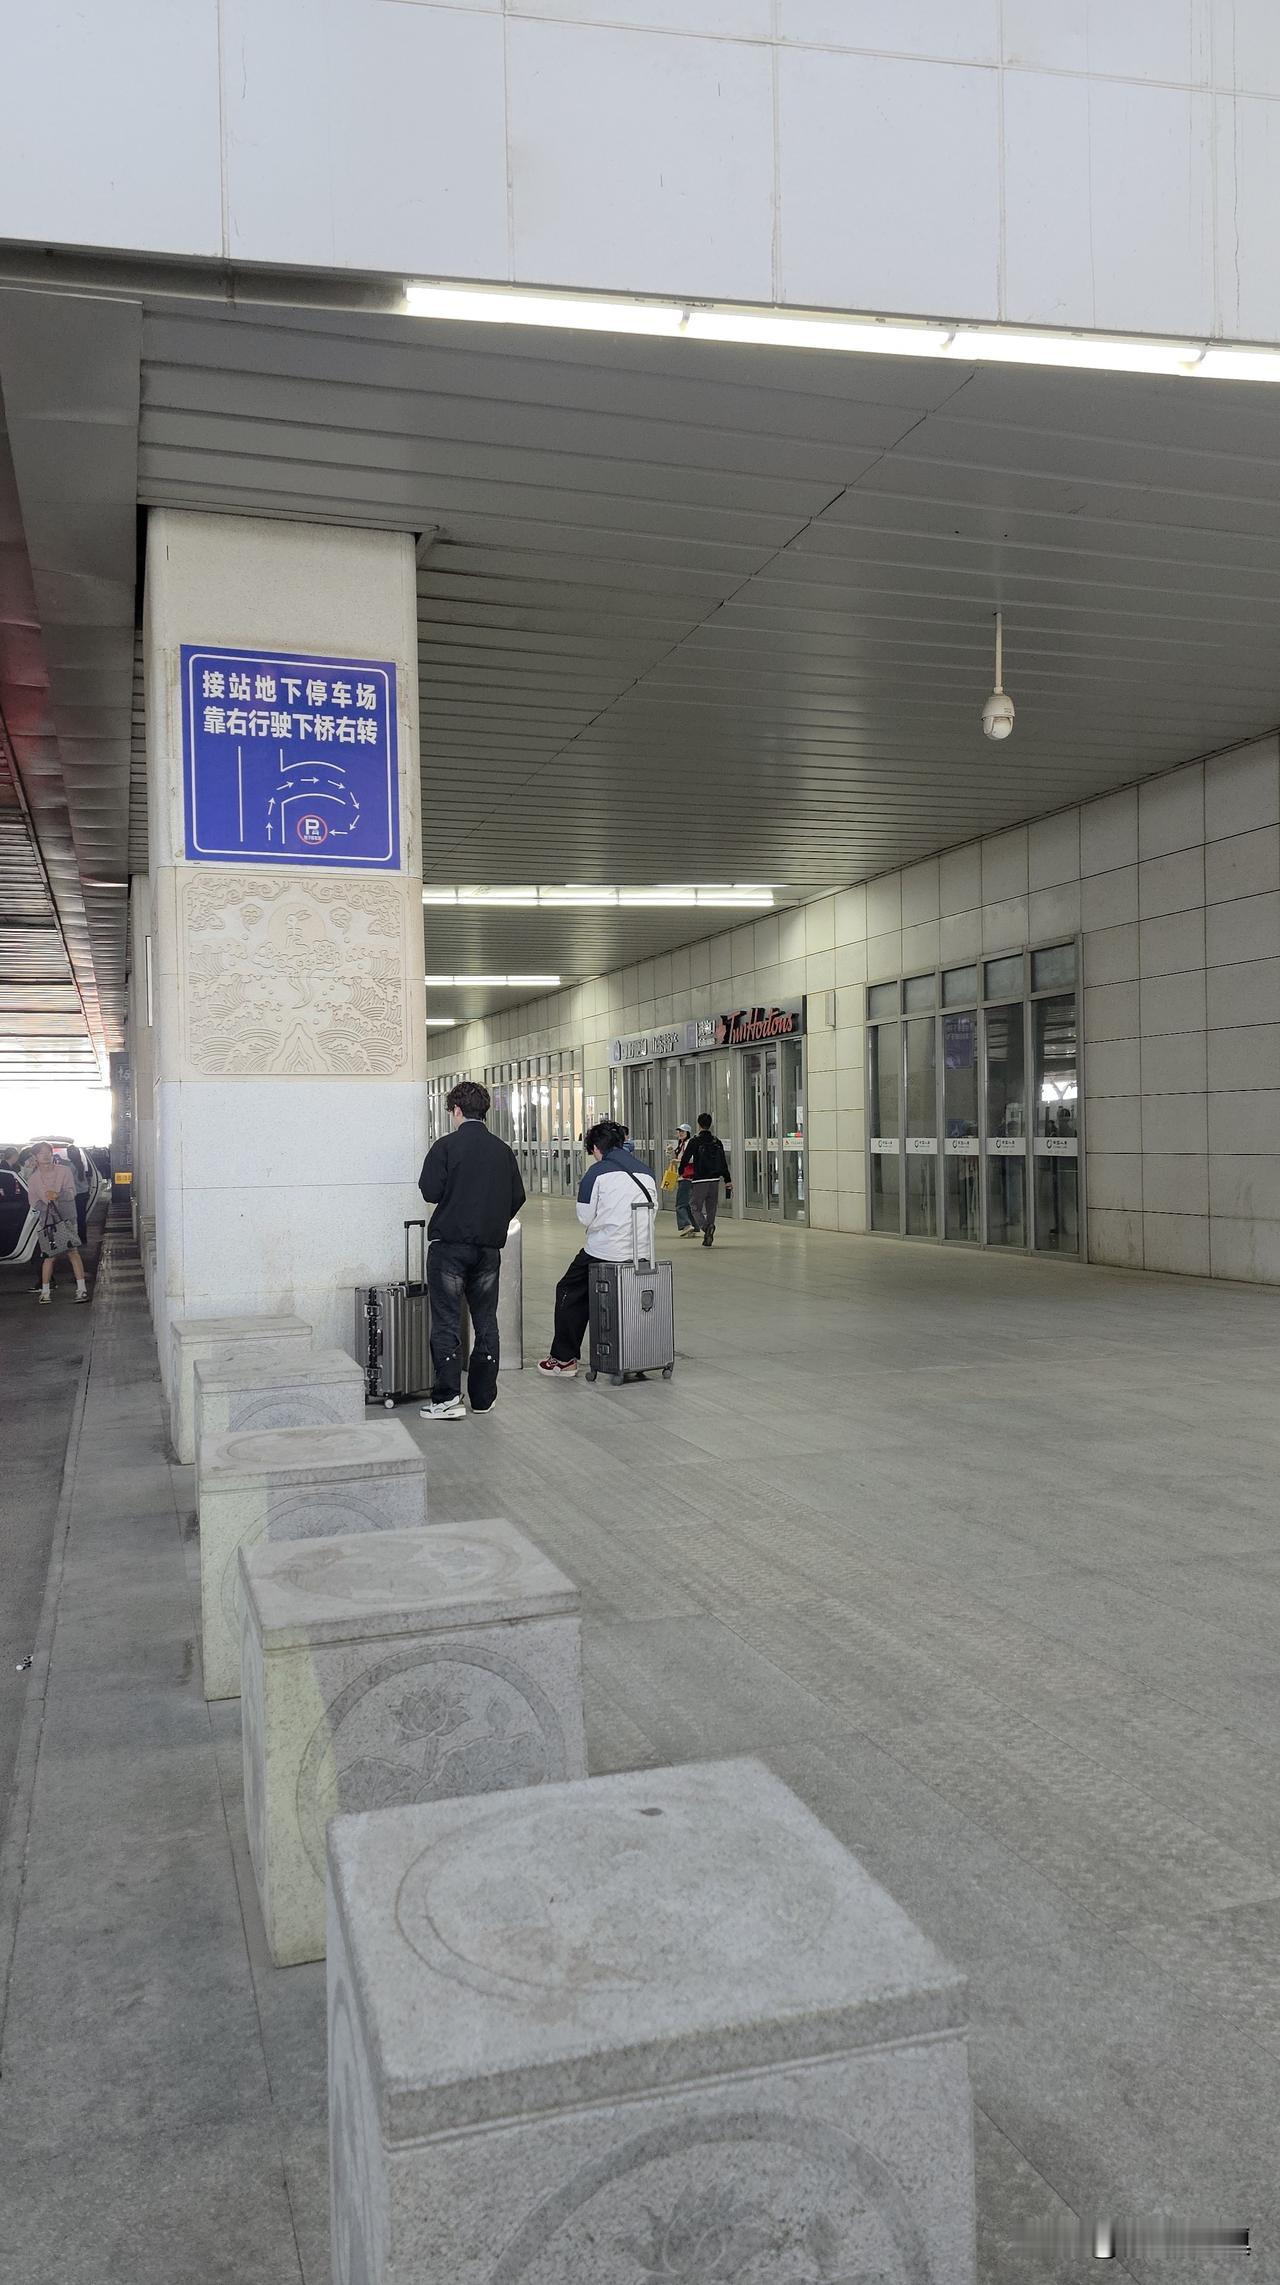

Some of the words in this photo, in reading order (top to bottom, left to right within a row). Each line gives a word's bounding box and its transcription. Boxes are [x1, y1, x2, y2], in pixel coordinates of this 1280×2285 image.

[203, 670, 377, 711] 接站地下停车场
[203, 705, 378, 745] 靠右行驶下桥右转
[305, 818, 320, 835] P
